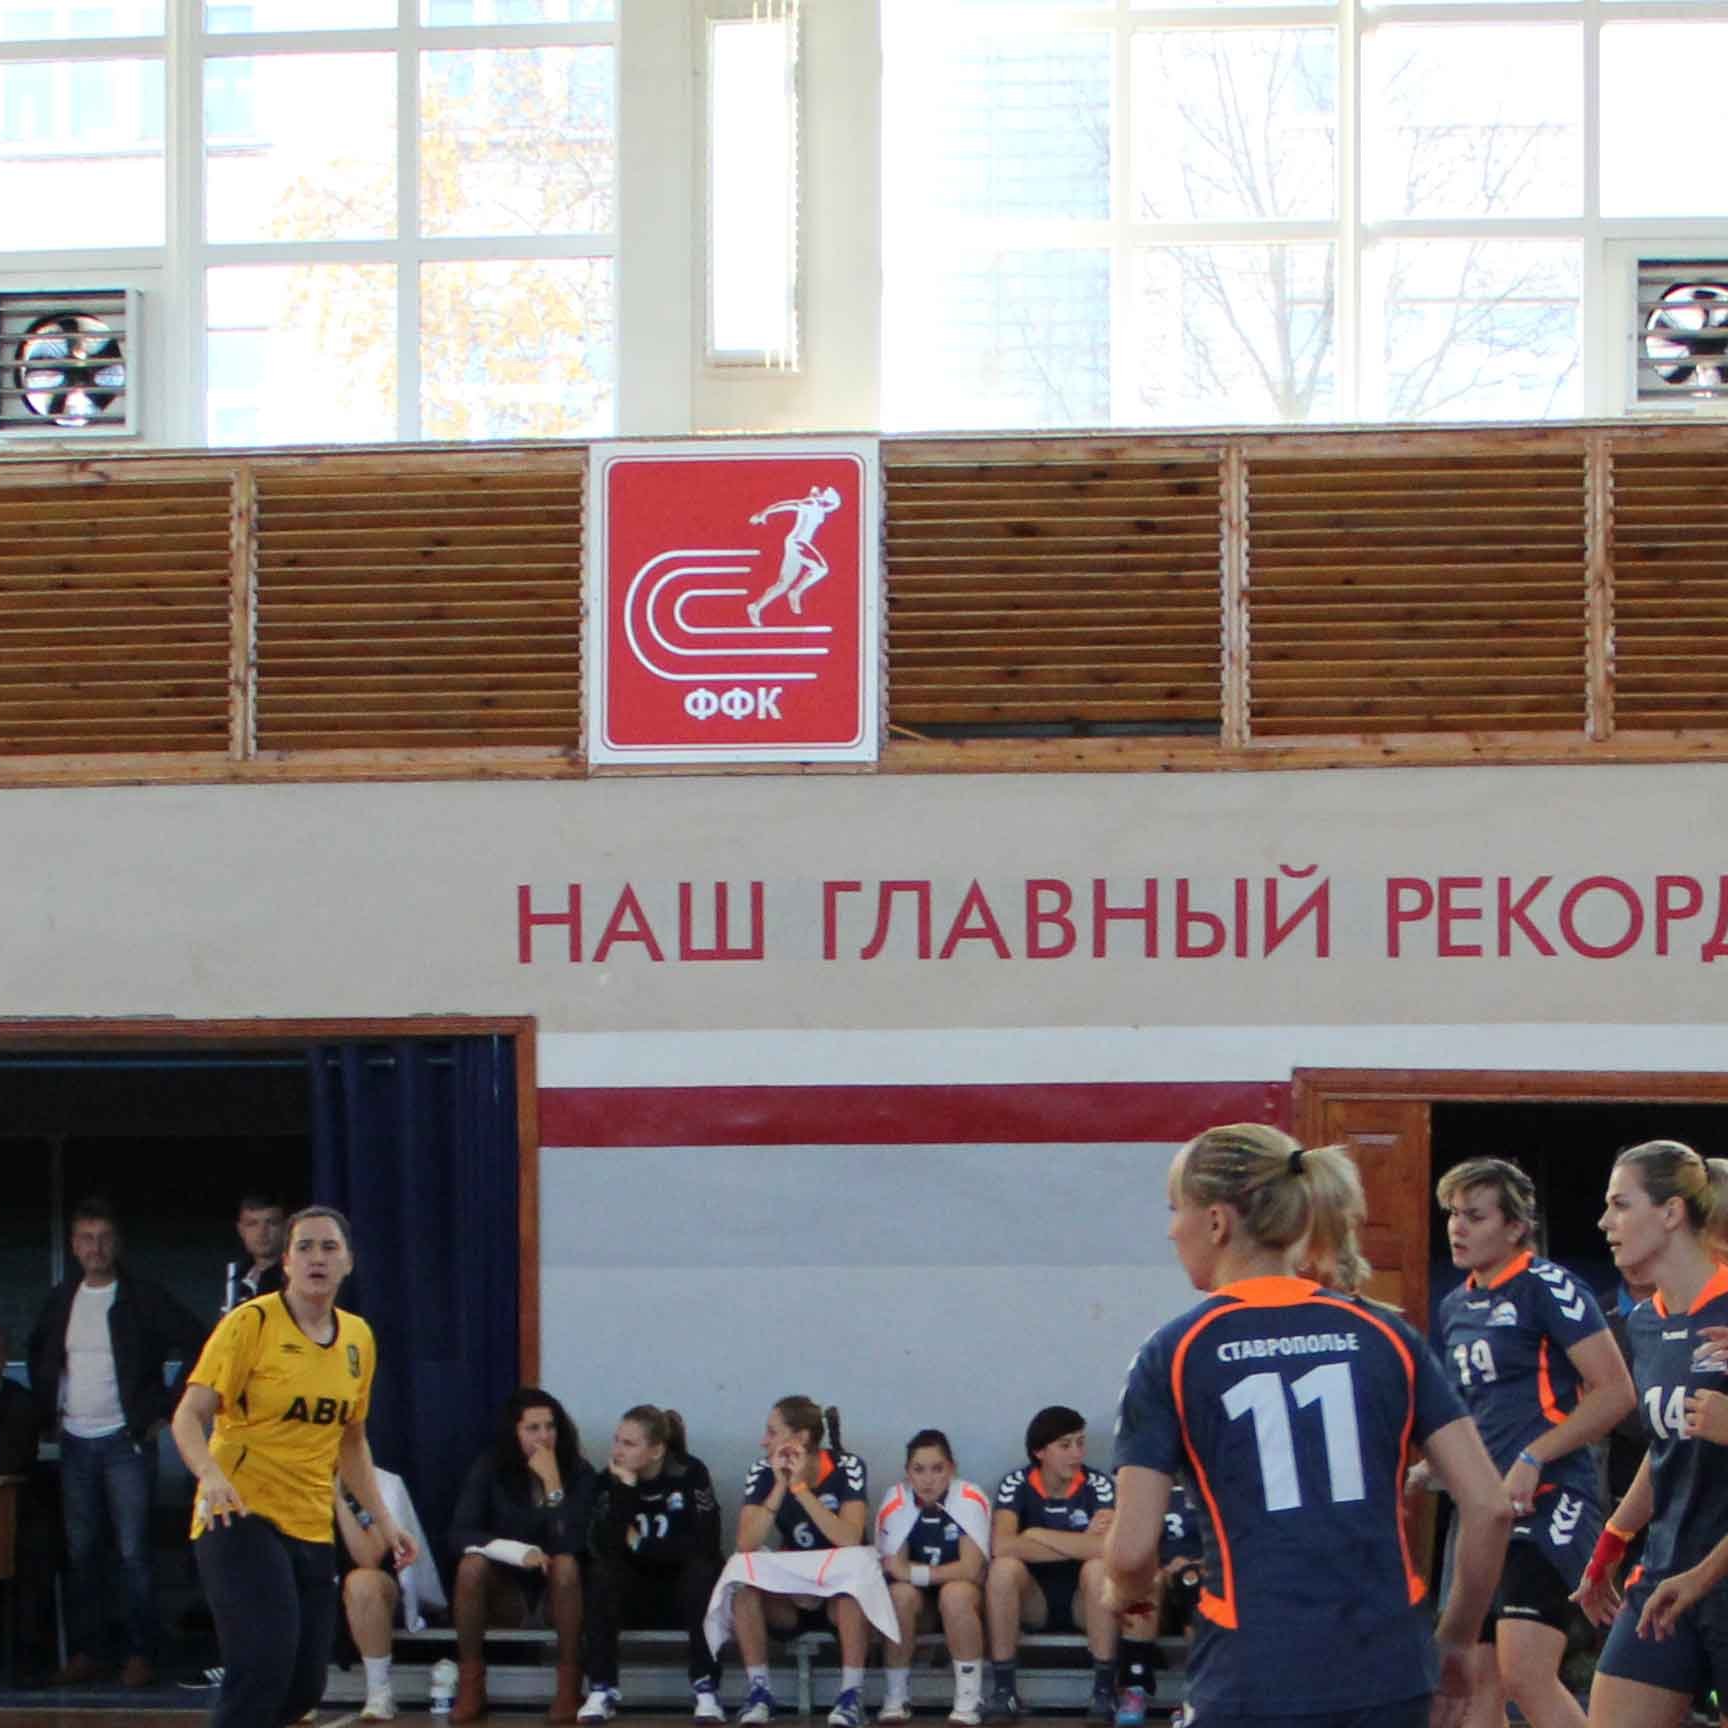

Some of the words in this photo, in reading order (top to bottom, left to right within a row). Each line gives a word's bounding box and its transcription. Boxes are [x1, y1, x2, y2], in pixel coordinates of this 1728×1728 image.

[684, 687, 783, 720] ФФК
[517, 881, 764, 964] НАШ
[823, 864, 1331, 962] ГЛАВНЫЙ
[1217, 1333, 1360, 1362] СТАВРОПОЛЬЕ
[1454, 1338, 1497, 1387] 19
[1221, 1361, 1366, 1511] 11
[1644, 1385, 1691, 1440] 14
[793, 1522, 815, 1548] 6
